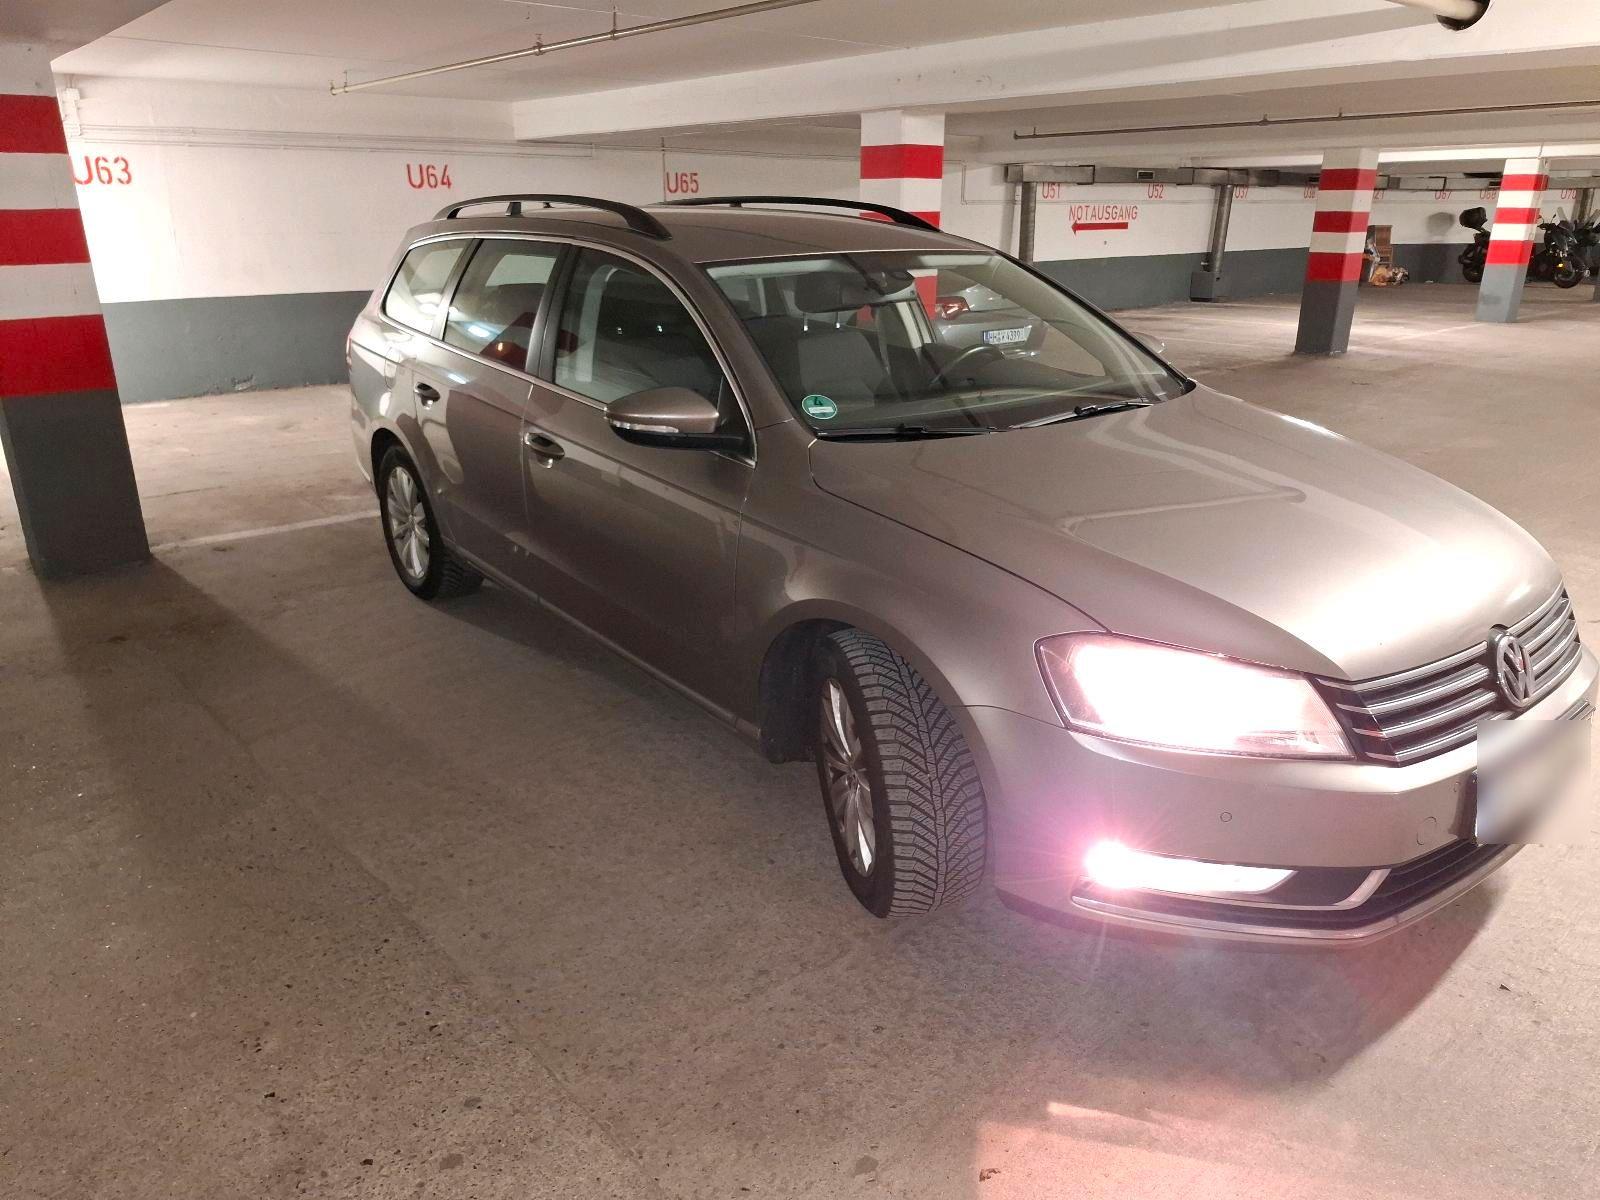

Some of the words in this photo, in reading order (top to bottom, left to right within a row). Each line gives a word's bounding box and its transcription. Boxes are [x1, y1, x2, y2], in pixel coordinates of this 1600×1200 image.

[73, 156, 132, 185] U63
[406, 164, 452, 189] U64
[666, 171, 699, 193] U65
[1041, 182, 1061, 199] U51
[1147, 183, 1165, 199] U52
[1069, 205, 1139, 221] NOTAUSGANG
